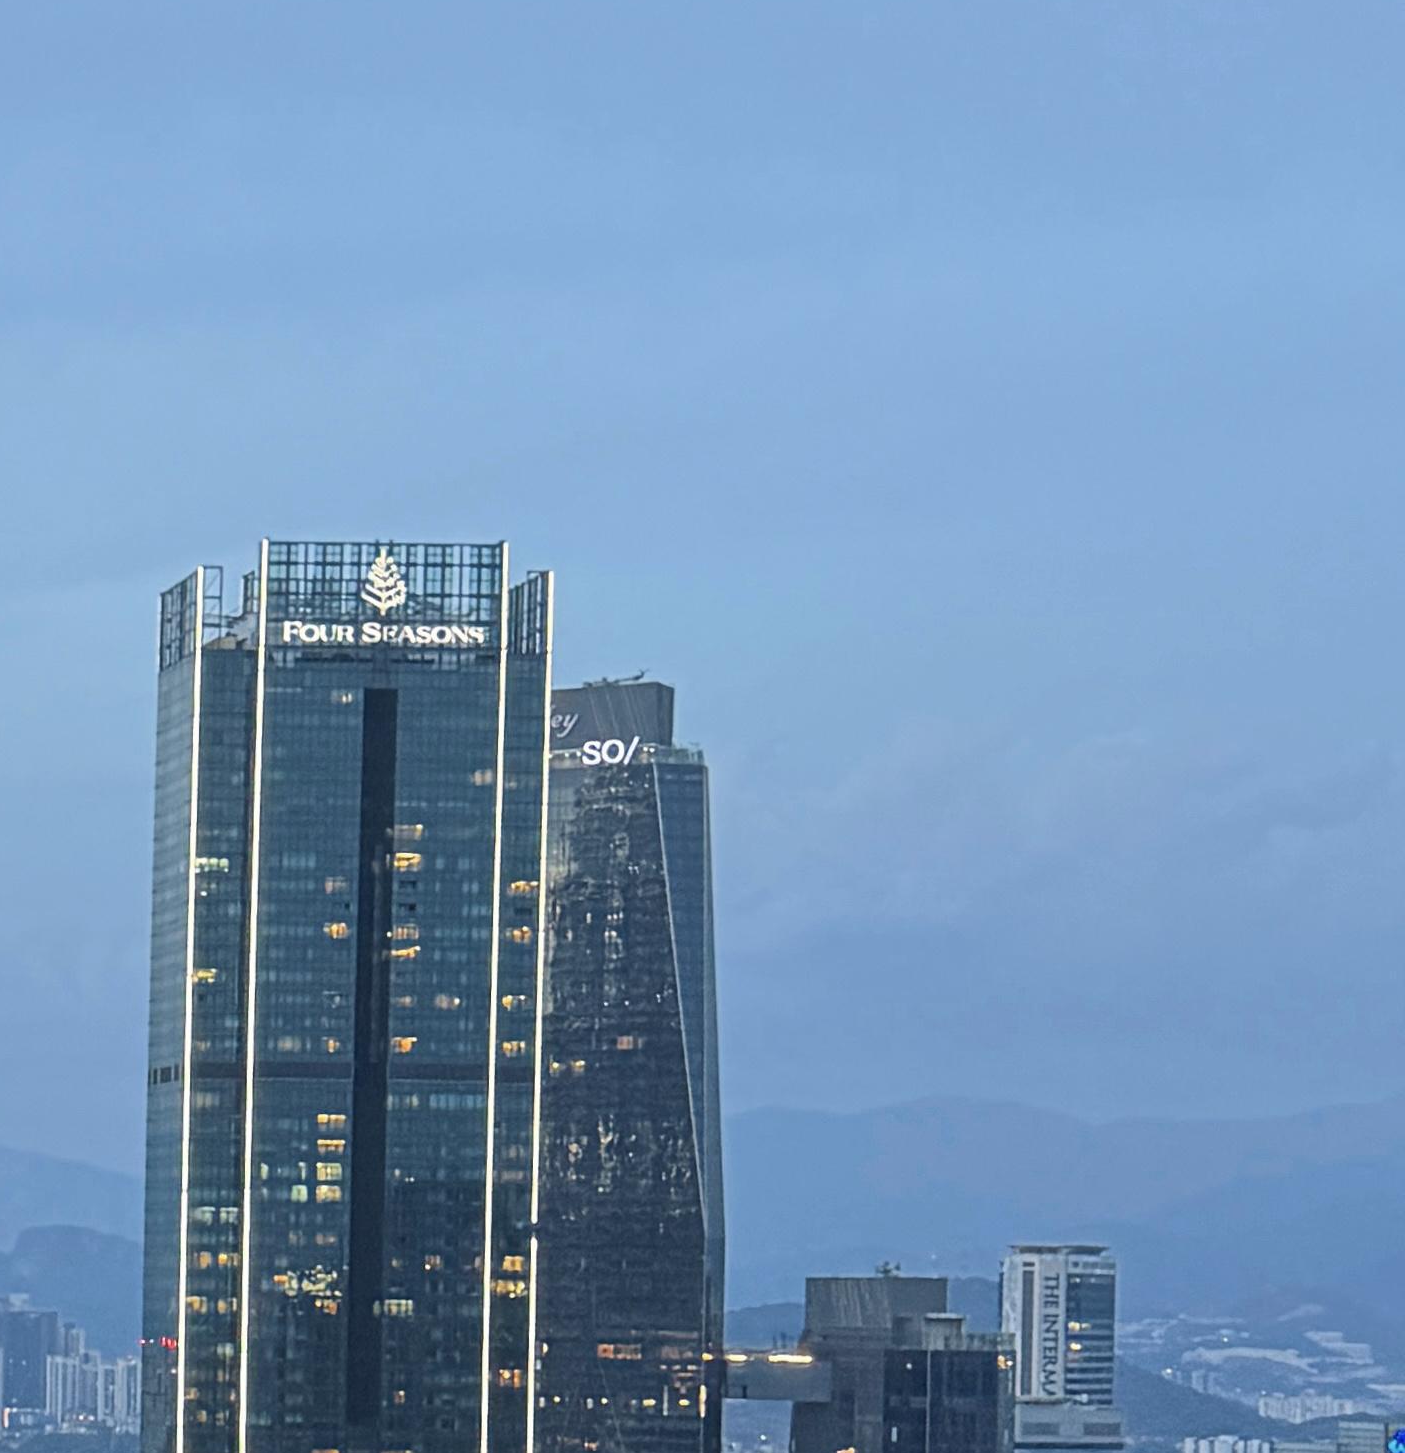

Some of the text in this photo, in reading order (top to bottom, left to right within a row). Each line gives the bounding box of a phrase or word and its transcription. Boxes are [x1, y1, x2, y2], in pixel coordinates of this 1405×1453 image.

[283, 620, 484, 644] FOUR SEASONS
[550, 704, 579, 738] ey
[1042, 1273, 1060, 1309] THE
